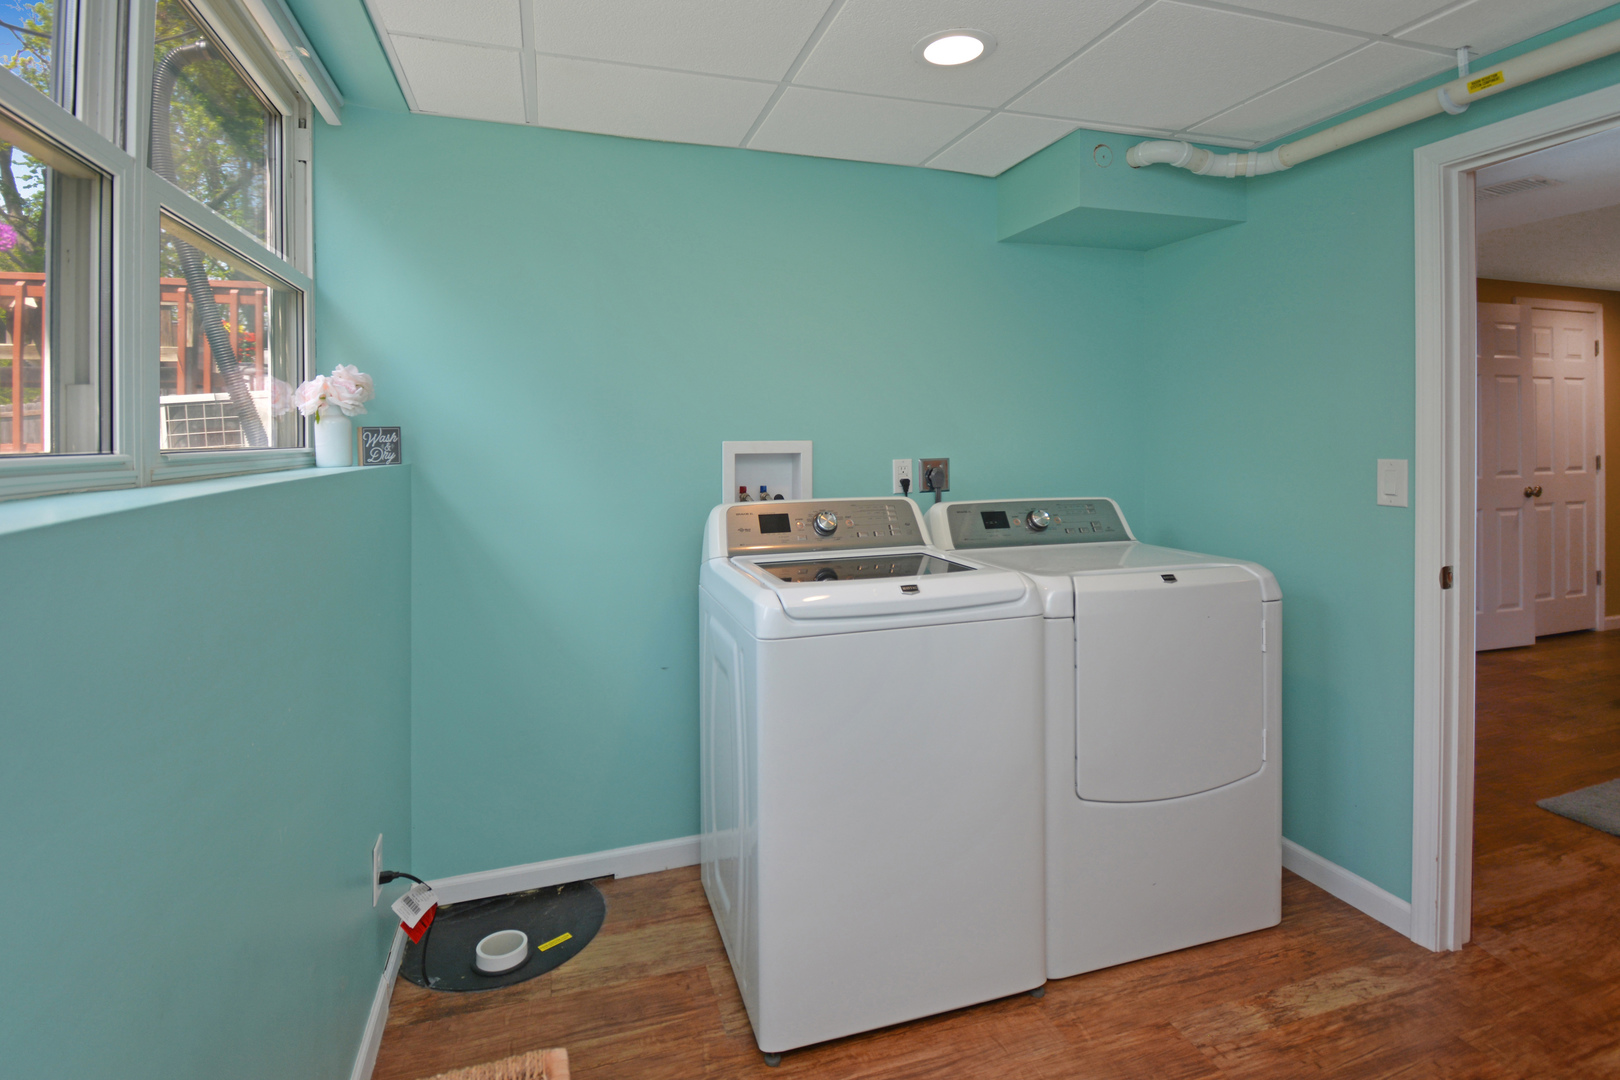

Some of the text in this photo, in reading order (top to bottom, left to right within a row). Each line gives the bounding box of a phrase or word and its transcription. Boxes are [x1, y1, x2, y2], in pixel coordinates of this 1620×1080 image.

[362, 427, 398, 448] Wash
[367, 447, 396, 465] Dry
[384, 443, 391, 451] &
